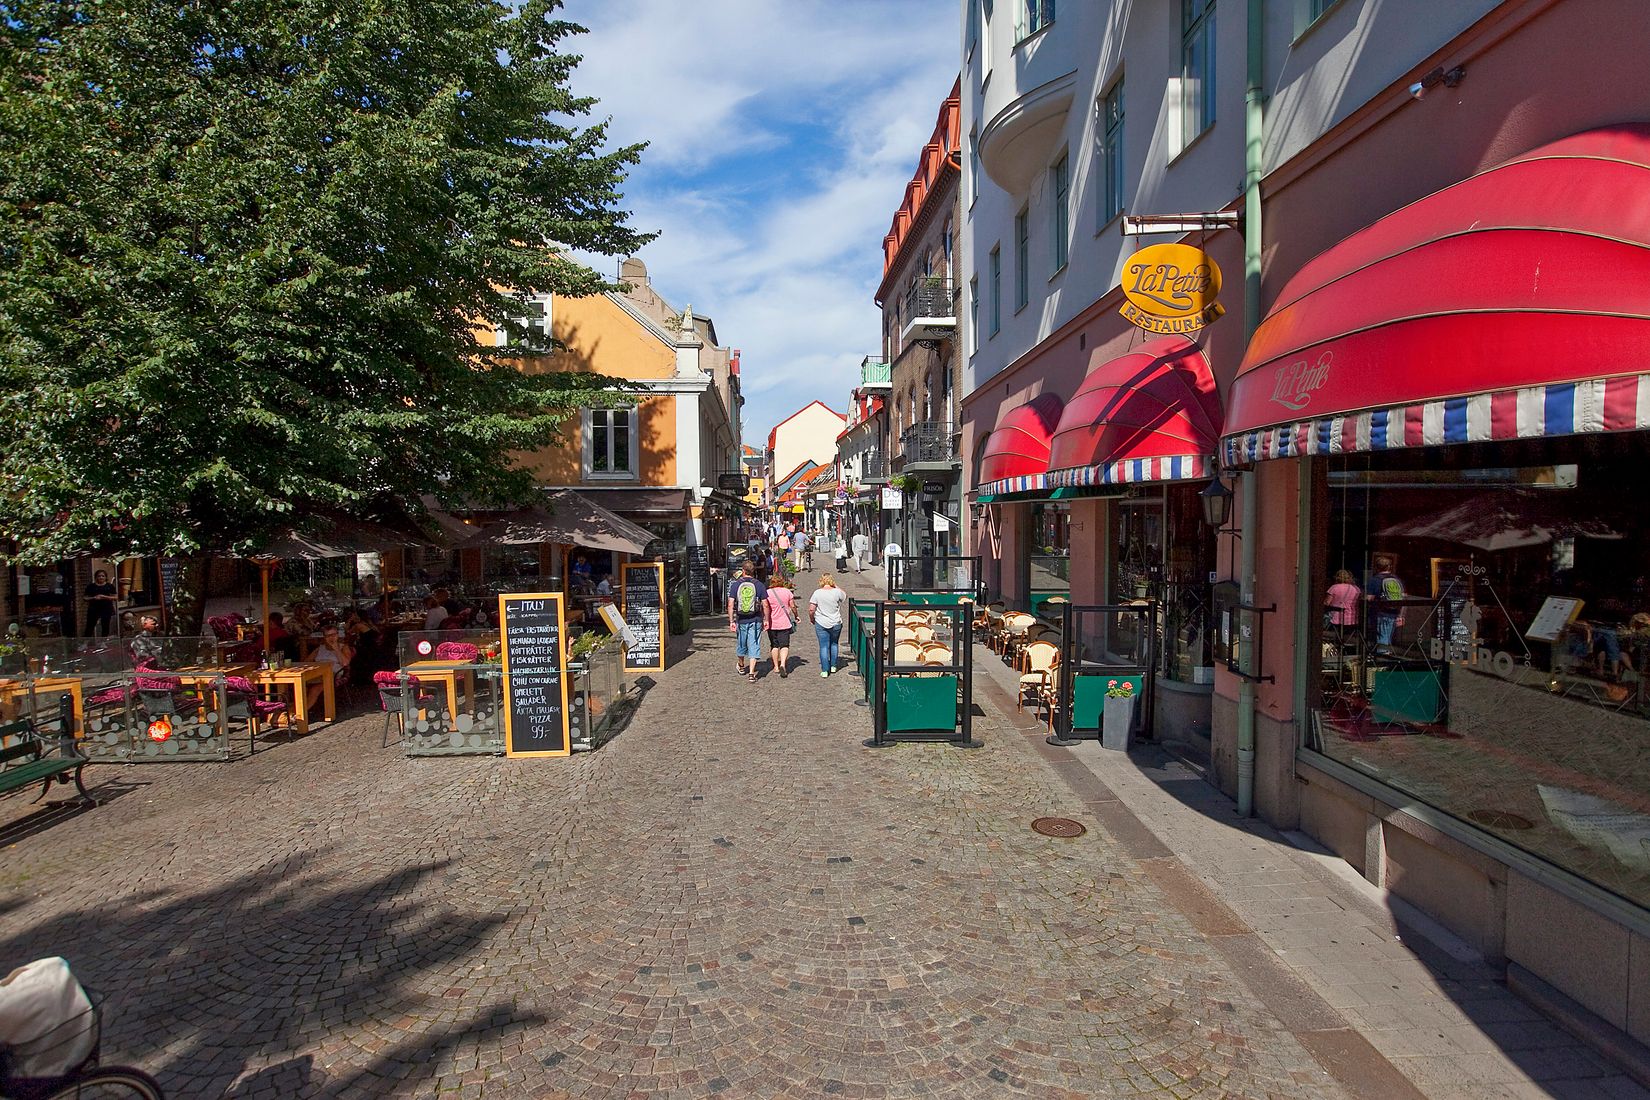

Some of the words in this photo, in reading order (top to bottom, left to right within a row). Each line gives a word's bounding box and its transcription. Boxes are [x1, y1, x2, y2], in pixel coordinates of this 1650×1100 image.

[1156, 264, 1211, 293] Petite
[1124, 304, 1219, 332] RESTAURANT
[924, 484, 943, 492] FRISÖR
[521, 600, 544, 611] ITALY
[511, 646, 552, 655] KÖTTRÄTTER
[511, 656, 552, 665] FISKRÄTTER
[512, 676, 527, 687] CHILI
[514, 687, 544, 697] OMELETT
[515, 695, 547, 707] SALLADER
[516, 706, 534, 715] ÄKTA
[529, 714, 552, 724] PIZZA
